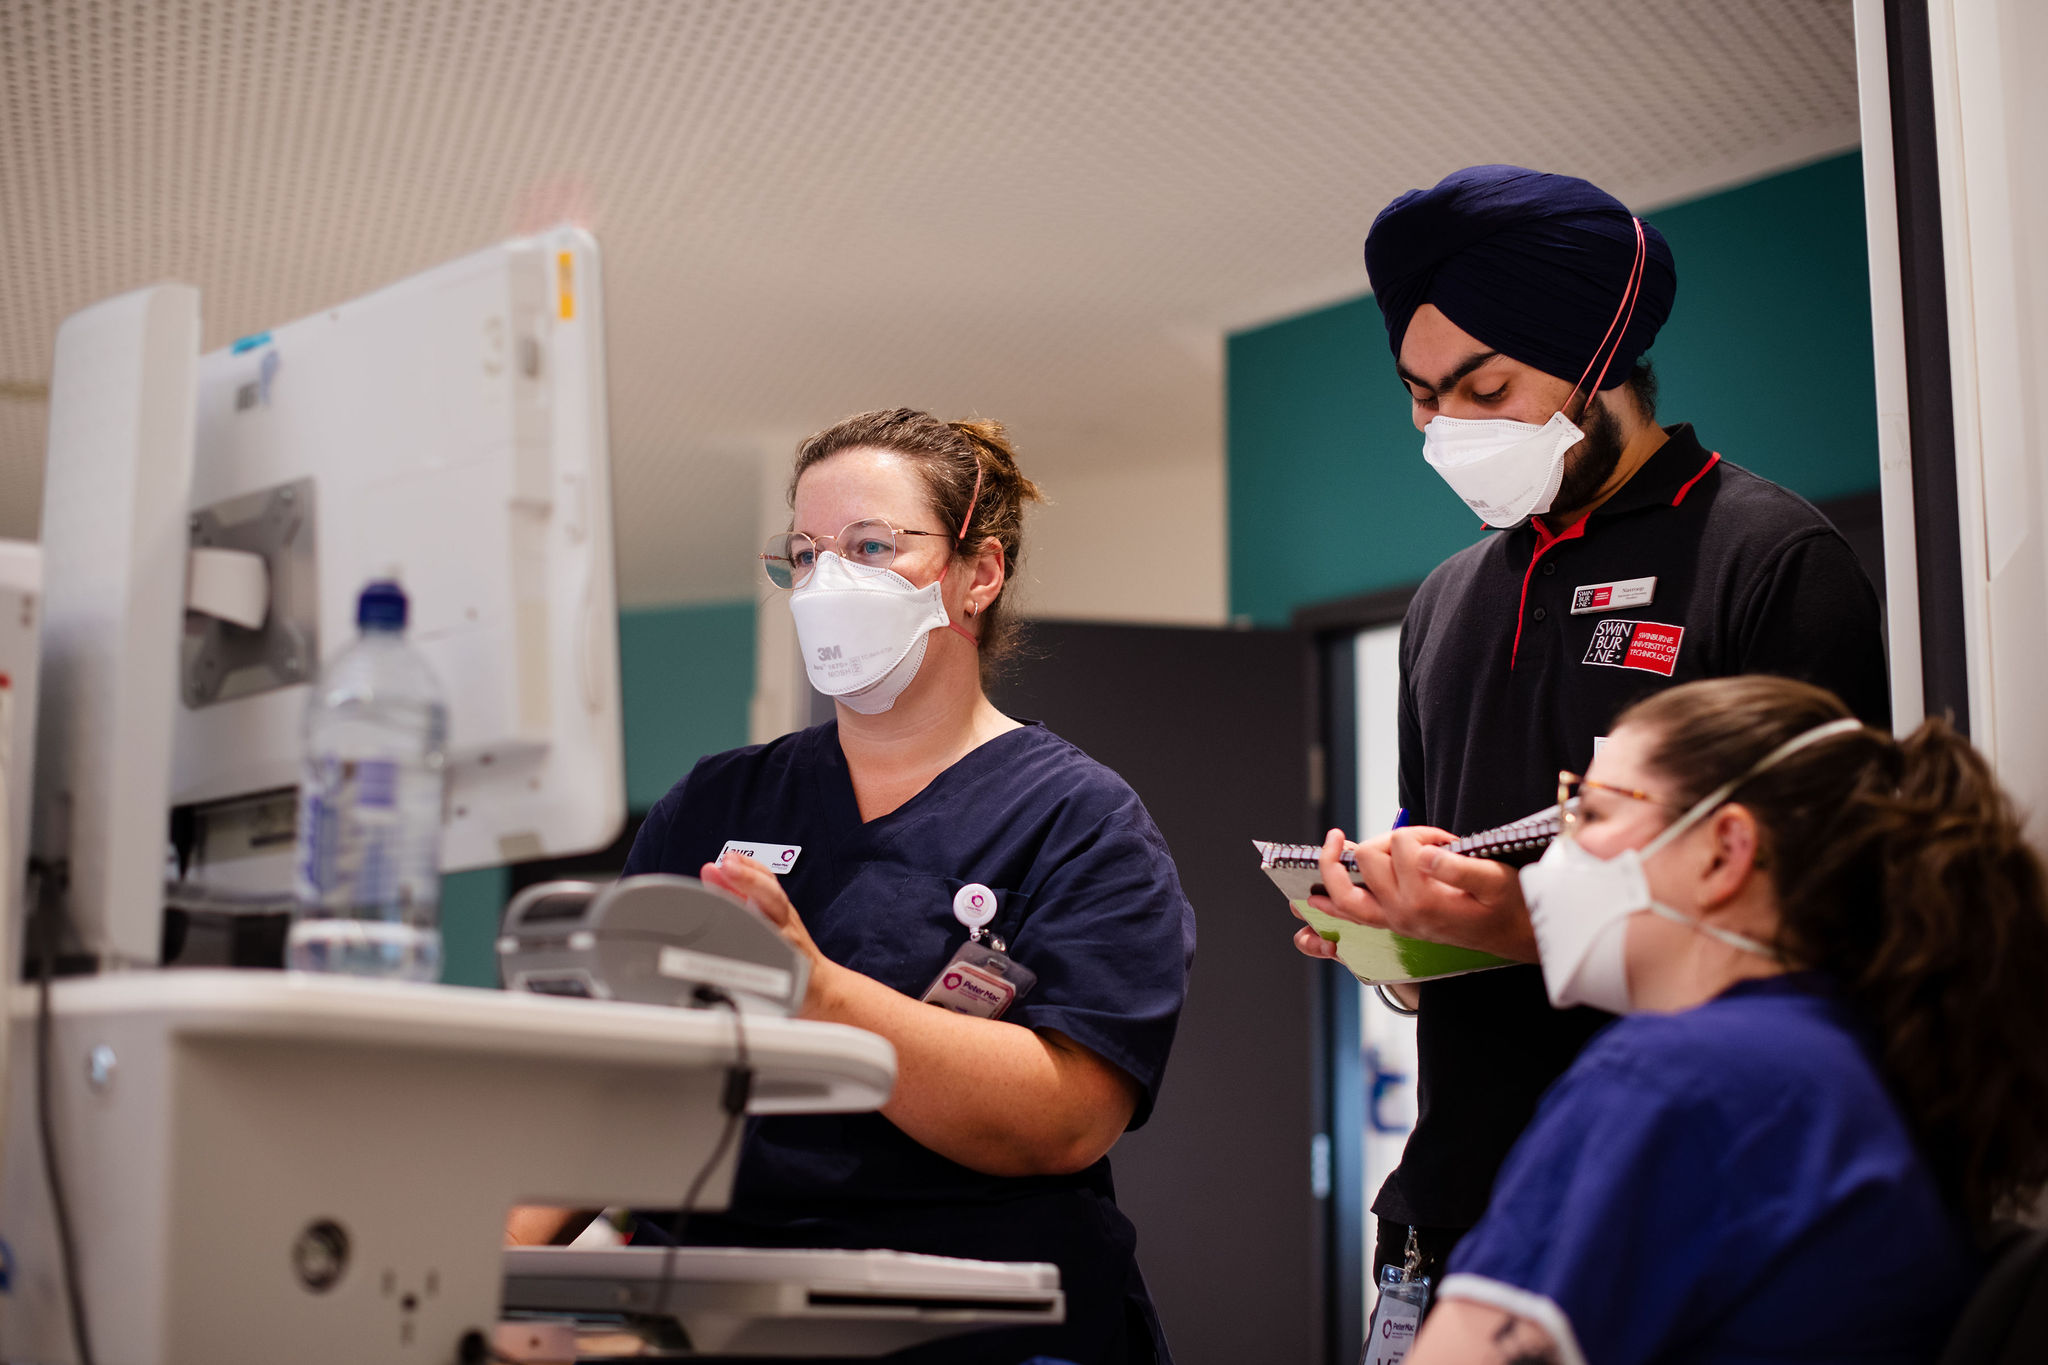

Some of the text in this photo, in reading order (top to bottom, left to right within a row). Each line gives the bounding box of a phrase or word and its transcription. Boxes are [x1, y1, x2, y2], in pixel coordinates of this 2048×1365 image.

[1595, 636, 1622, 650] BUR
[1638, 632, 1674, 644] SWINBURNE
[817, 645, 842, 661] 3M
[1631, 640, 1677, 654] UNIVERSITY OF
[1630, 648, 1673, 662] TECHNOLOGY
[963, 981, 984, 996] Peter
[984, 990, 1000, 1002] Mac
[1393, 1322, 1415, 1332] Peter Mac
